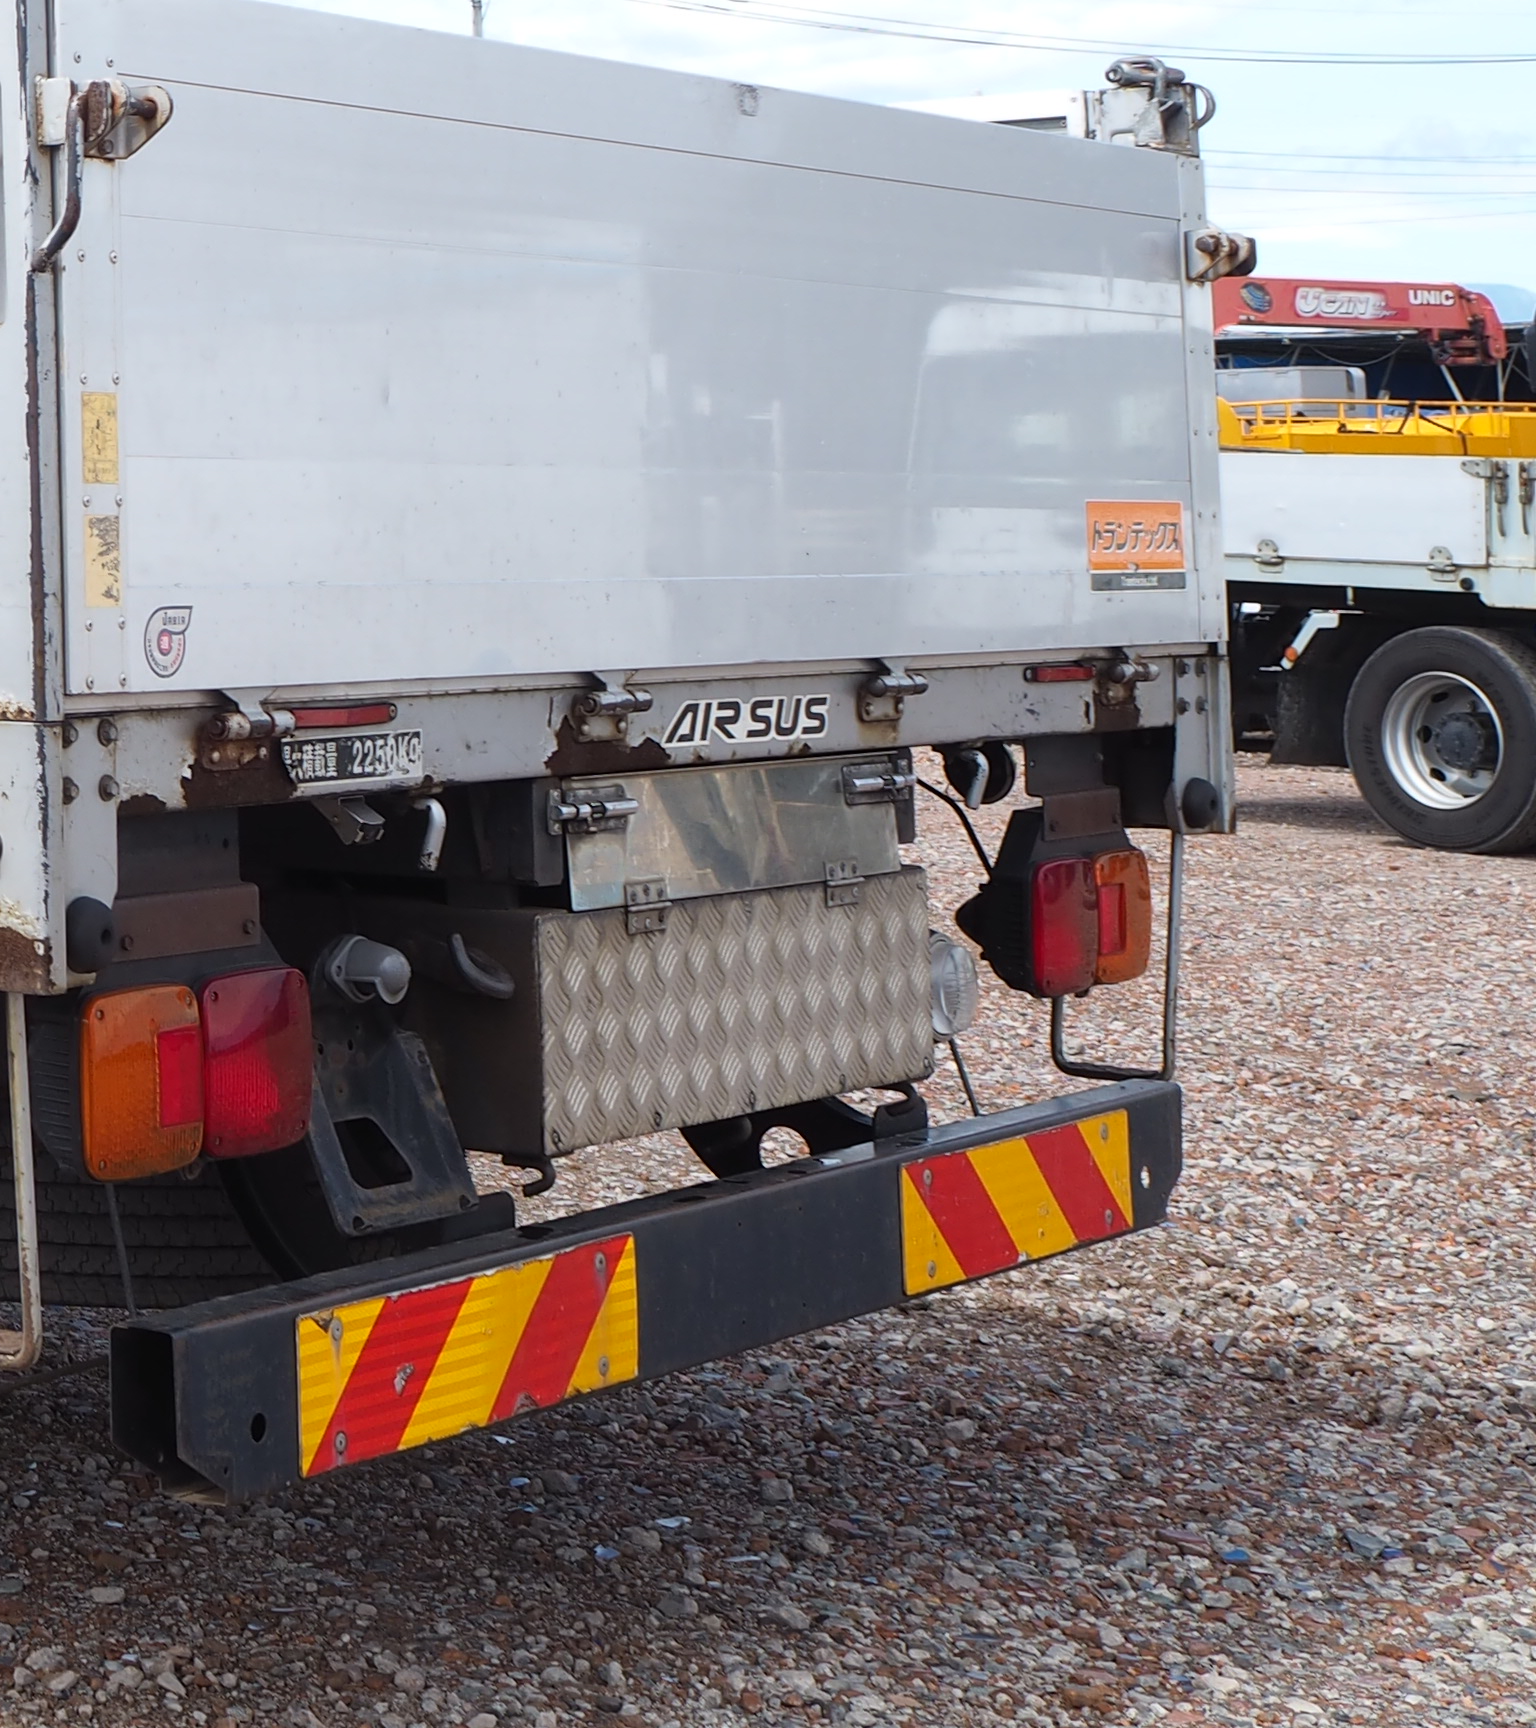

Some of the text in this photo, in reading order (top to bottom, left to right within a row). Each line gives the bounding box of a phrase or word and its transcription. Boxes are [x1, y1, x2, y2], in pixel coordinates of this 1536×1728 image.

[1408, 289, 1456, 306] UNIC
[1091, 520, 1181, 553] トランテックス
